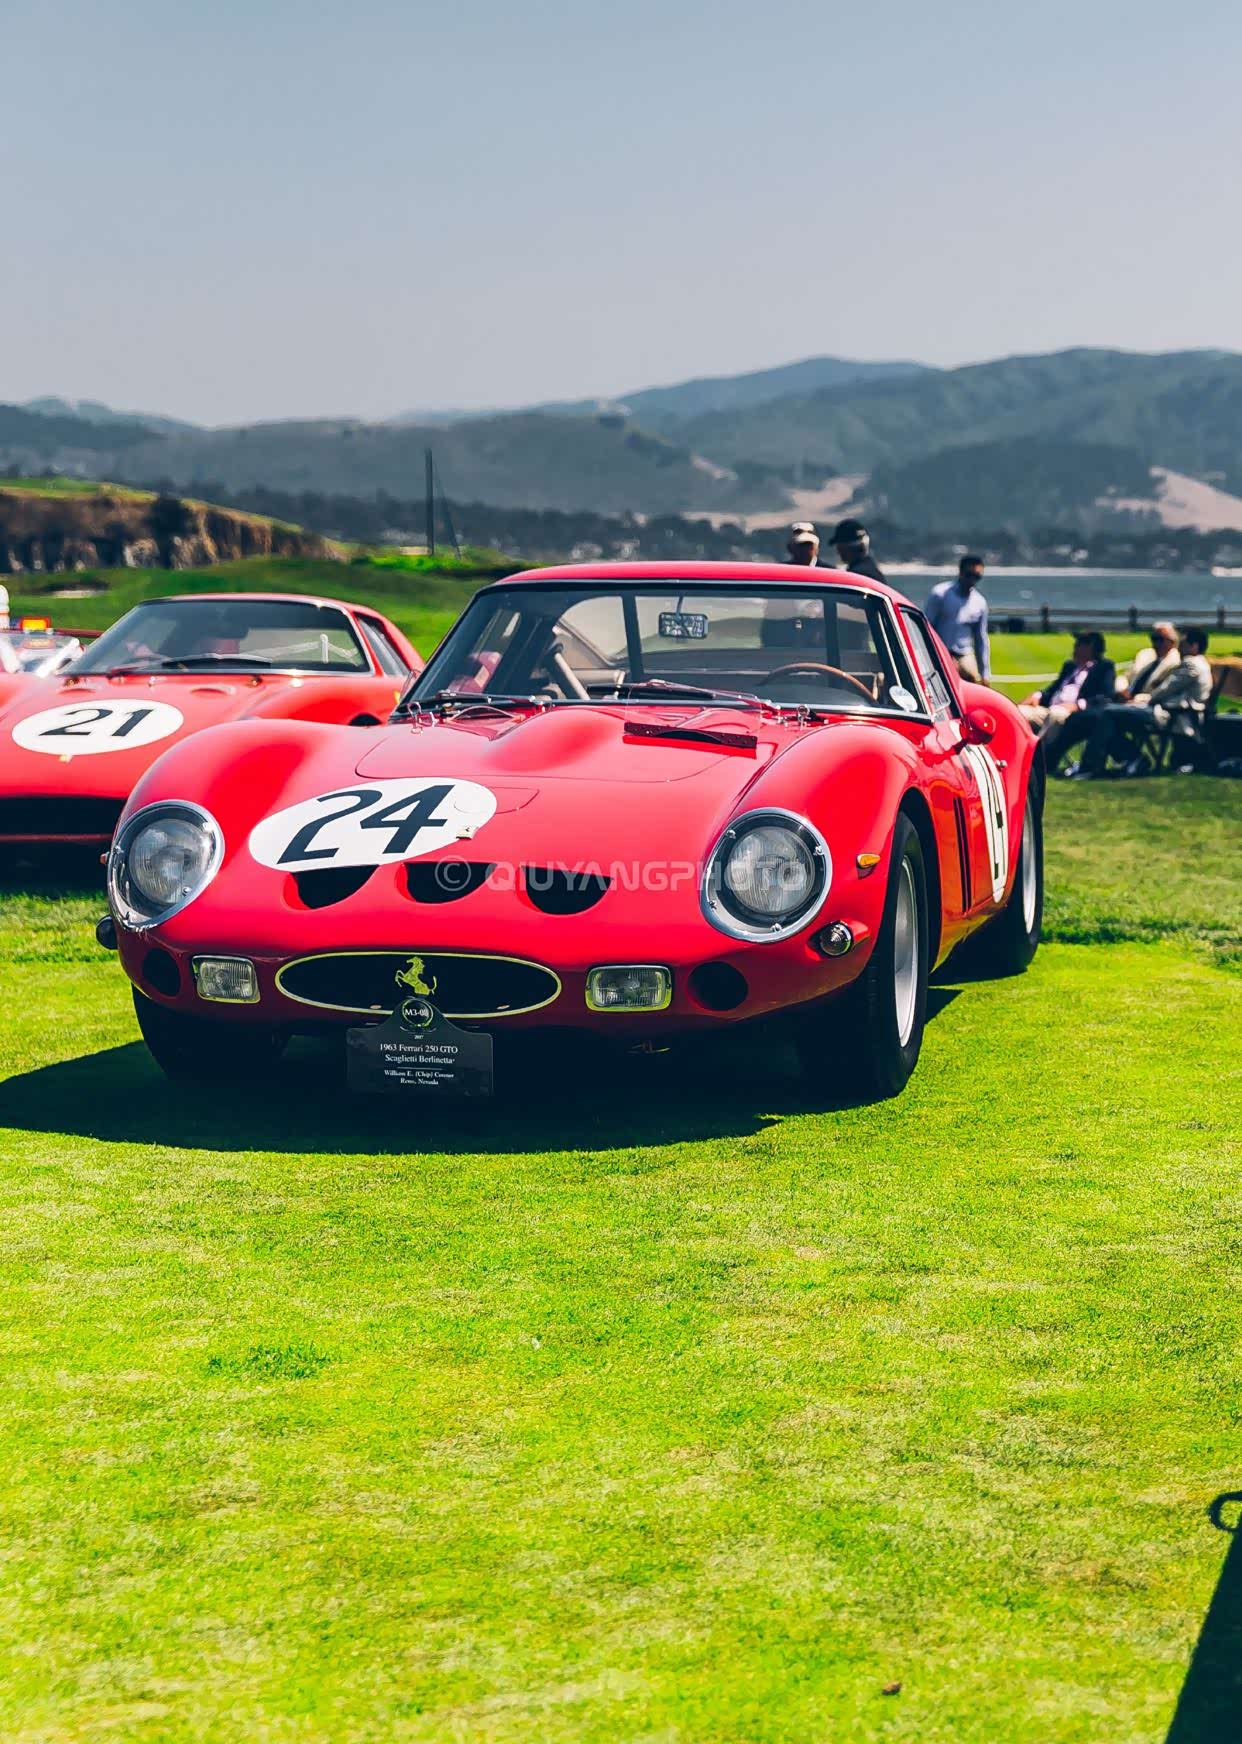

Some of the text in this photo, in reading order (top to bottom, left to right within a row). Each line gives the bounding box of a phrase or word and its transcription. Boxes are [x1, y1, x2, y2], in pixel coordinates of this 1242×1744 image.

[38, 708, 155, 737] 21
[276, 784, 456, 865] 24
[380, 1043, 459, 1054] 1963 Ferrari 250 GTO
[385, 1054, 418, 1064] Scaglietti
